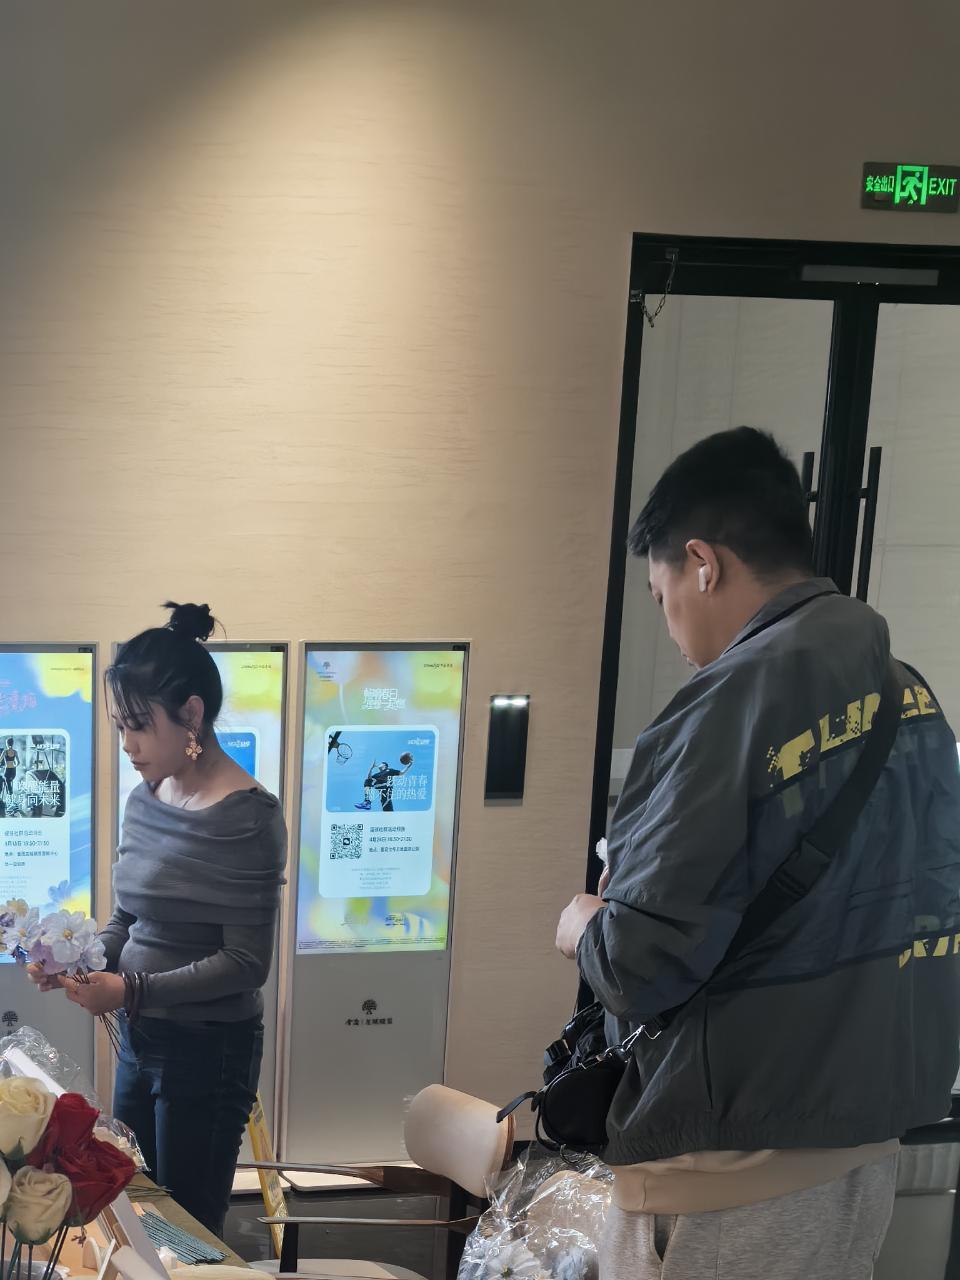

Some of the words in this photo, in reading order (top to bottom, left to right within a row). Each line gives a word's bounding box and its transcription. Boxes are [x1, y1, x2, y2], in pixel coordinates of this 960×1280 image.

[865, 175, 895, 192] 安全出口
[928, 177, 957, 195] EXIT
